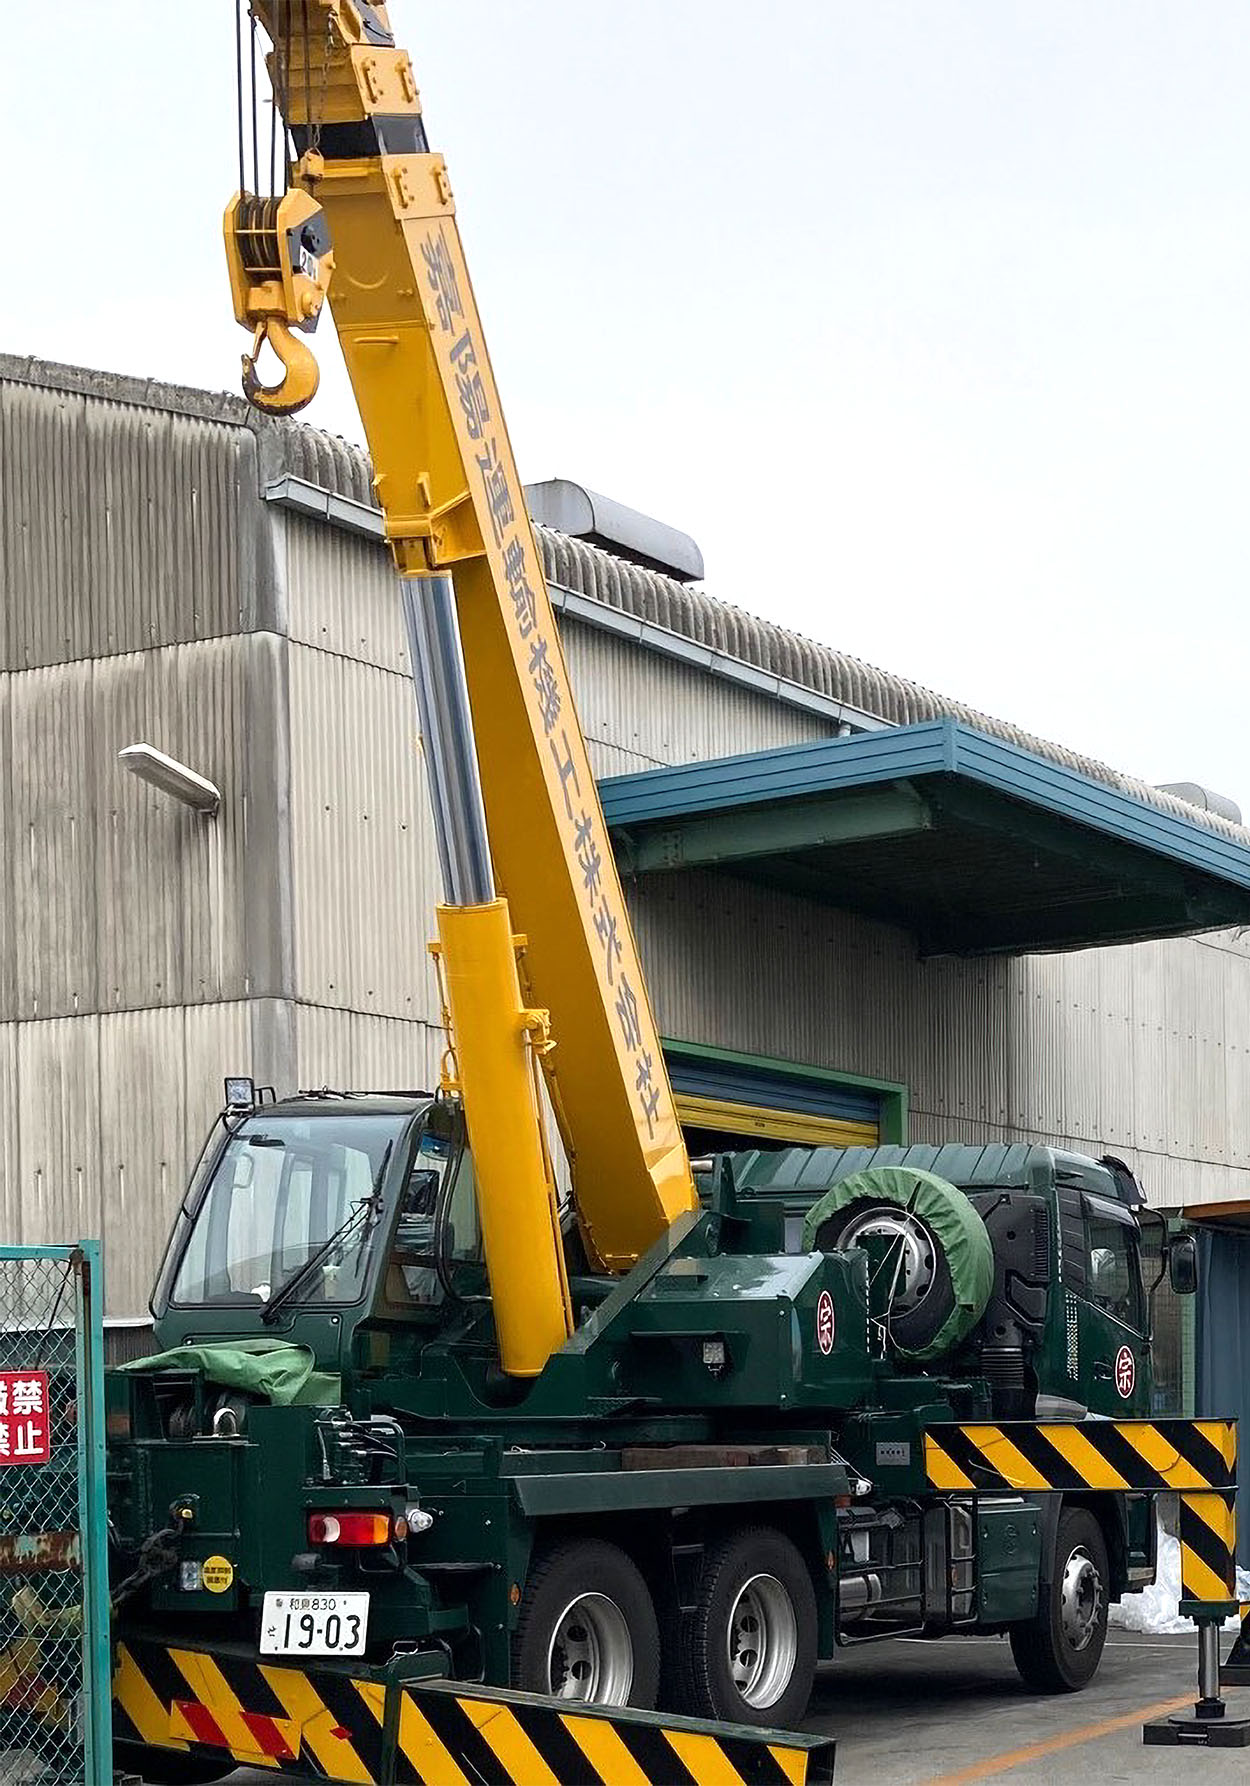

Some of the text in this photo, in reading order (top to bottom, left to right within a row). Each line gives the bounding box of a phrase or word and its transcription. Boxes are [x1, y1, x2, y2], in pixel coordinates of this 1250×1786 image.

[419, 221, 660, 1140] 嘉陽運輸機工株式会社
[1118, 1350, 1133, 1393] 宗
[0, 1379, 43, 1415] 禁
[283, 1613, 361, 1649] 19-03
